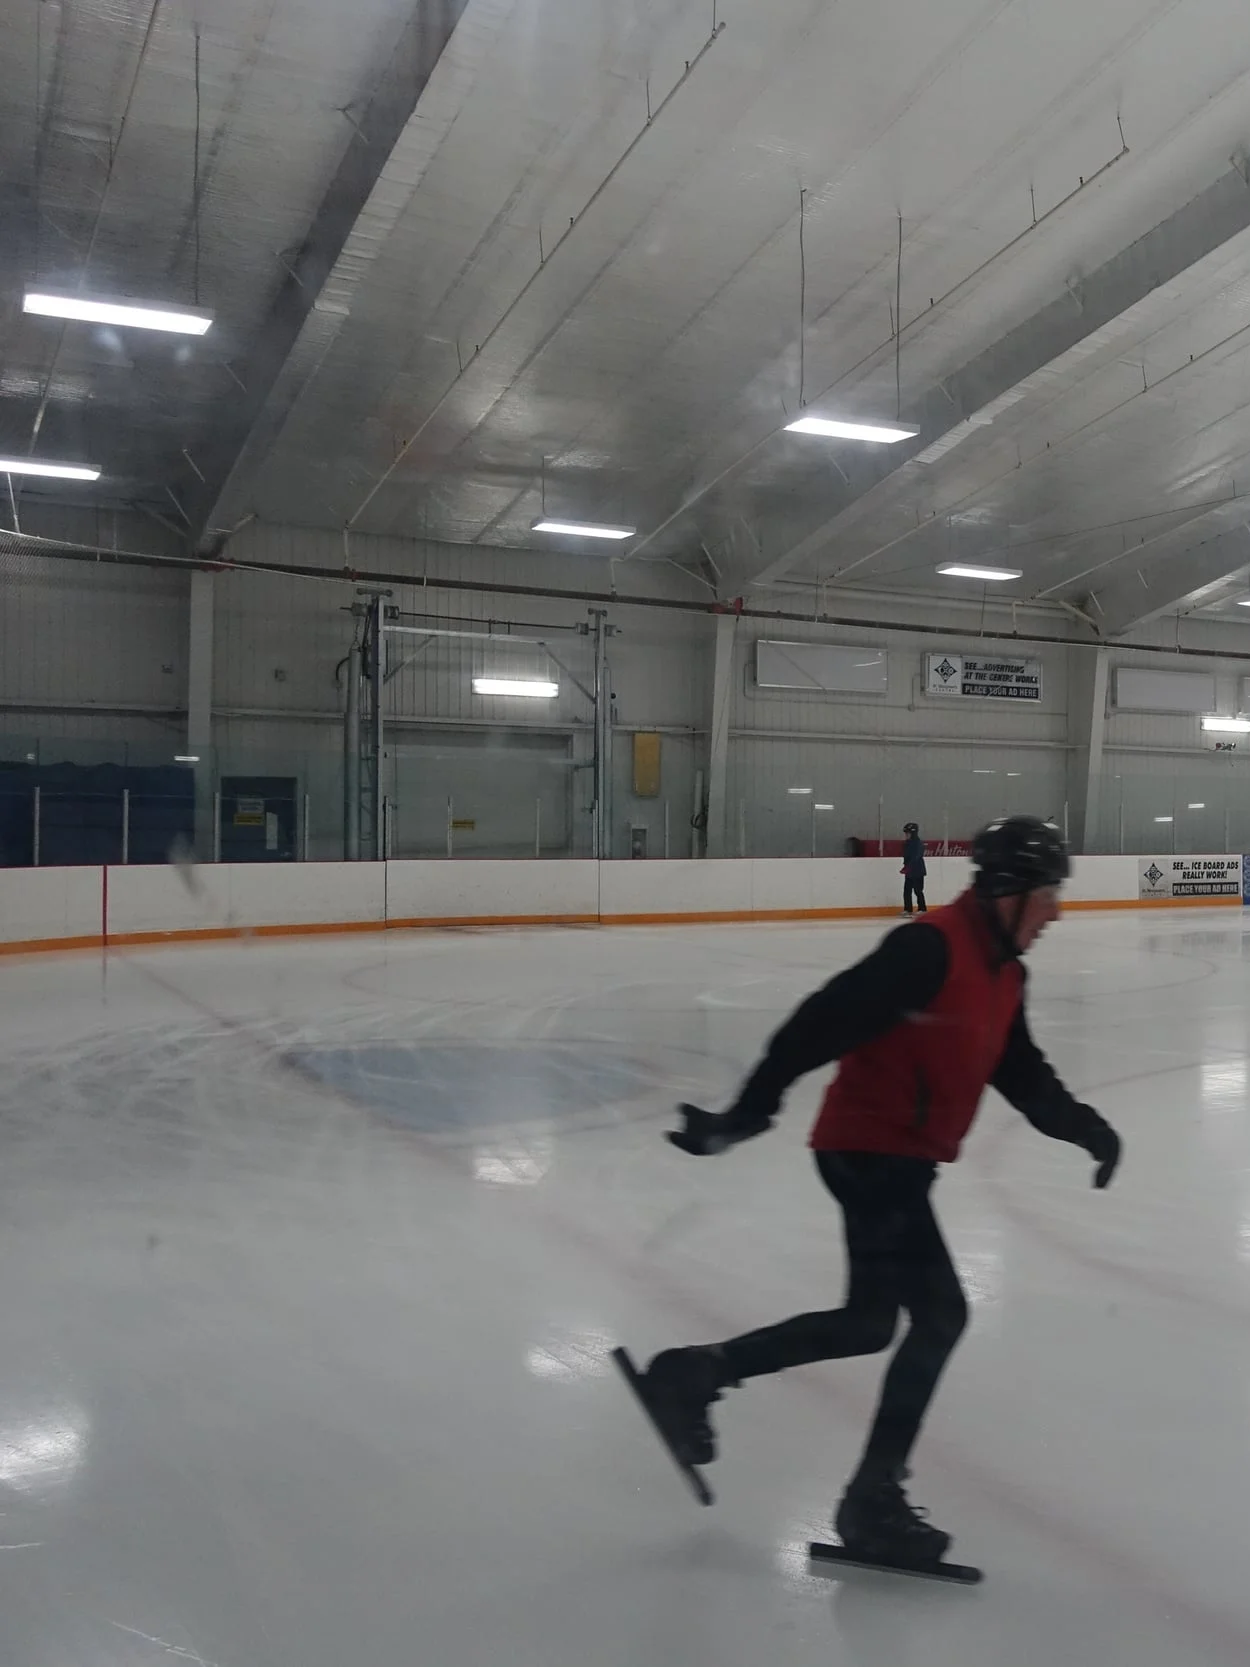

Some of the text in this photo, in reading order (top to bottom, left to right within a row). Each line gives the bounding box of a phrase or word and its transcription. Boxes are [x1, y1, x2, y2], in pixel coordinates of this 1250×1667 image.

[964, 672, 1038, 684] AT THE CENTRE WORKS
[964, 684, 1037, 697] PLACE YOUR AD HERE
[1191, 862, 1202, 870] ICE
[1203, 862, 1225, 870] BOARD
[1226, 861, 1239, 869] ADS
[1182, 871, 1228, 880] REALLY WORK!
[1173, 884, 1194, 894] PLACE
[1195, 884, 1212, 894] YOUR
[1212, 884, 1221, 894] AD
[1222, 883, 1238, 893] HERE
